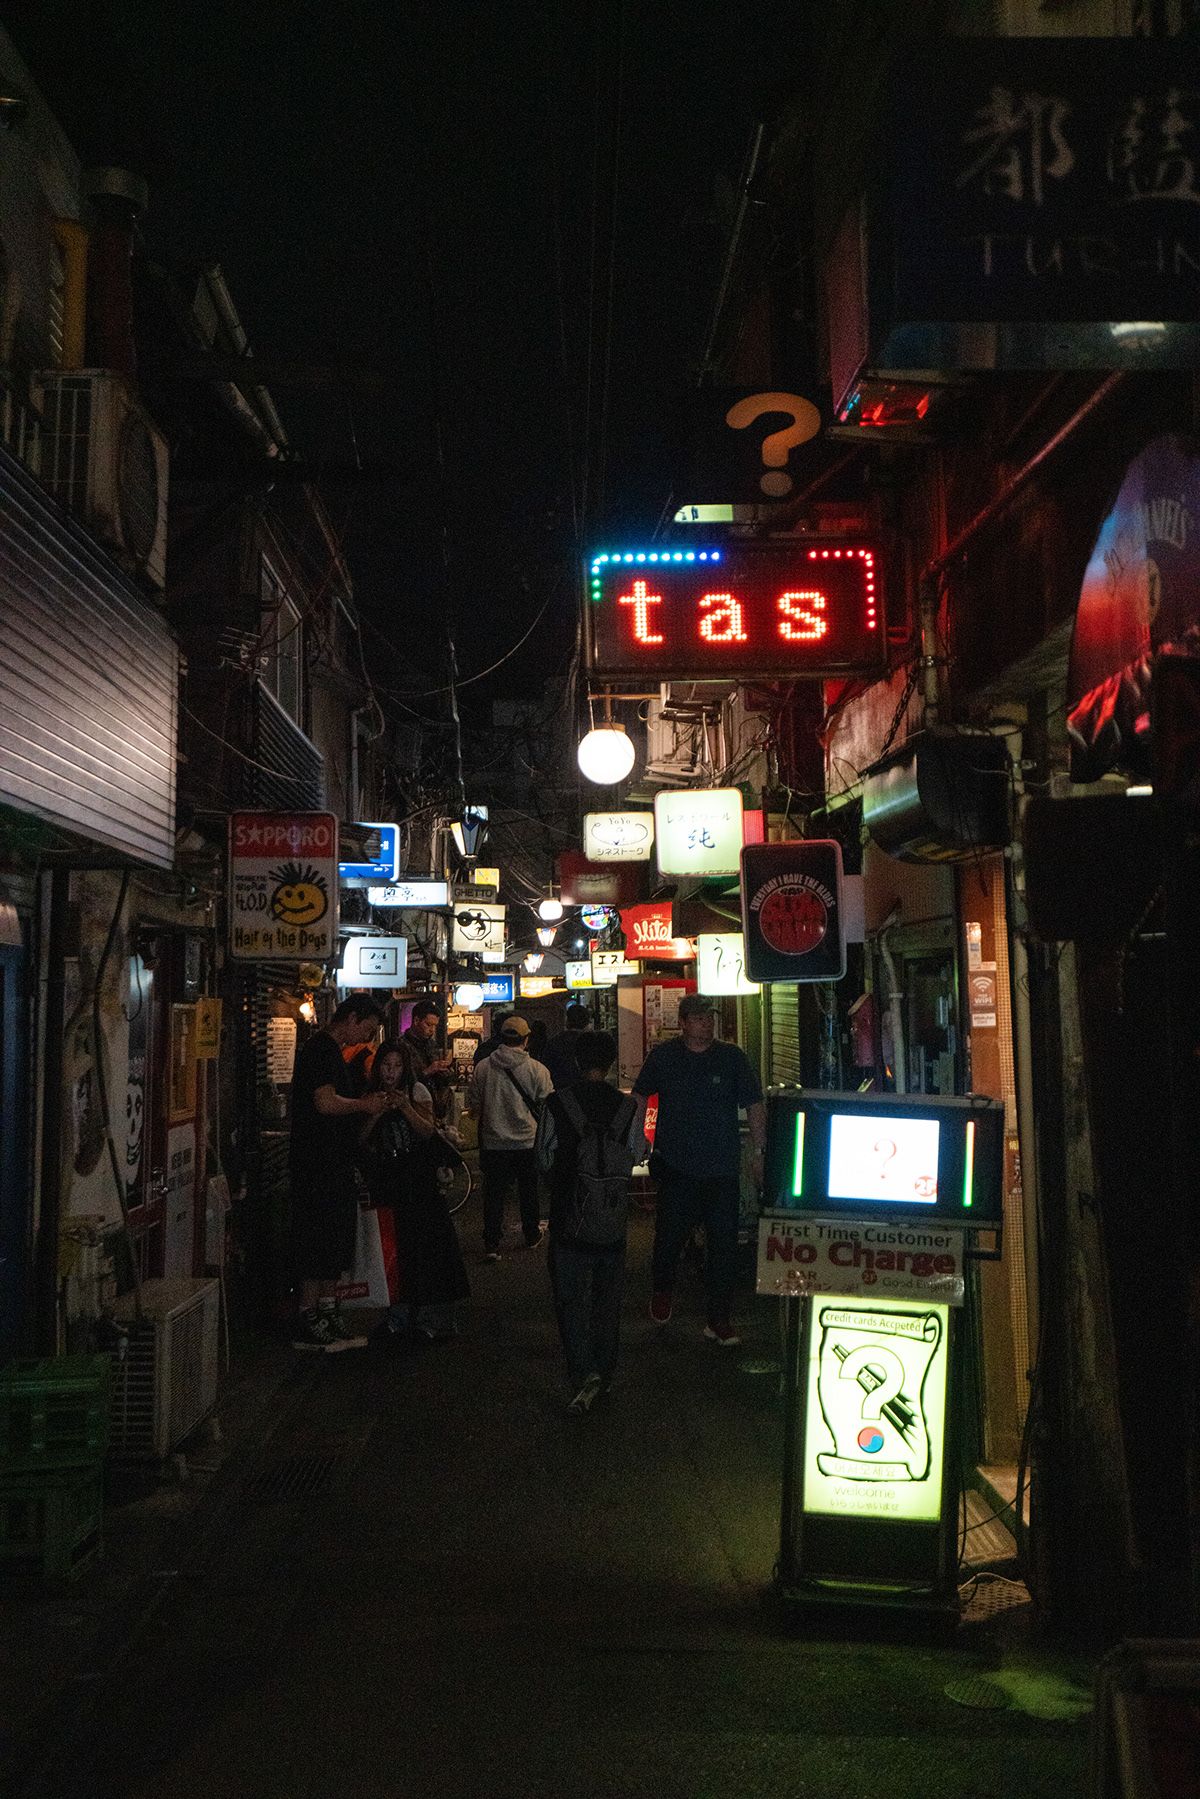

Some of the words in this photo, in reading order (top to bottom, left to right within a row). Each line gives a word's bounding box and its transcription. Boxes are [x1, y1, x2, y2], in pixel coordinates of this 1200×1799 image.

[687, 826, 717, 850] 純
[597, 847, 644, 856] シネストーク
[454, 887, 494, 898] GHETTO
[749, 876, 780, 912] EVERYDAY
[782, 873, 804, 884] HAVE
[802, 876, 820, 890] THE
[235, 926, 259, 947] Hair
[276, 926, 297, 947] the
[299, 928, 328, 950] Dogs
[770, 1222, 810, 1237] First
[818, 1226, 860, 1241] Time
[864, 1228, 953, 1248] Customer
[766, 1237, 818, 1264] No
[828, 1241, 956, 1277] Charge
[787, 1269, 817, 1281] BAR
[882, 1277, 914, 1290] Good
[825, 1310, 851, 1324] credit
[853, 1314, 878, 1328] cards
